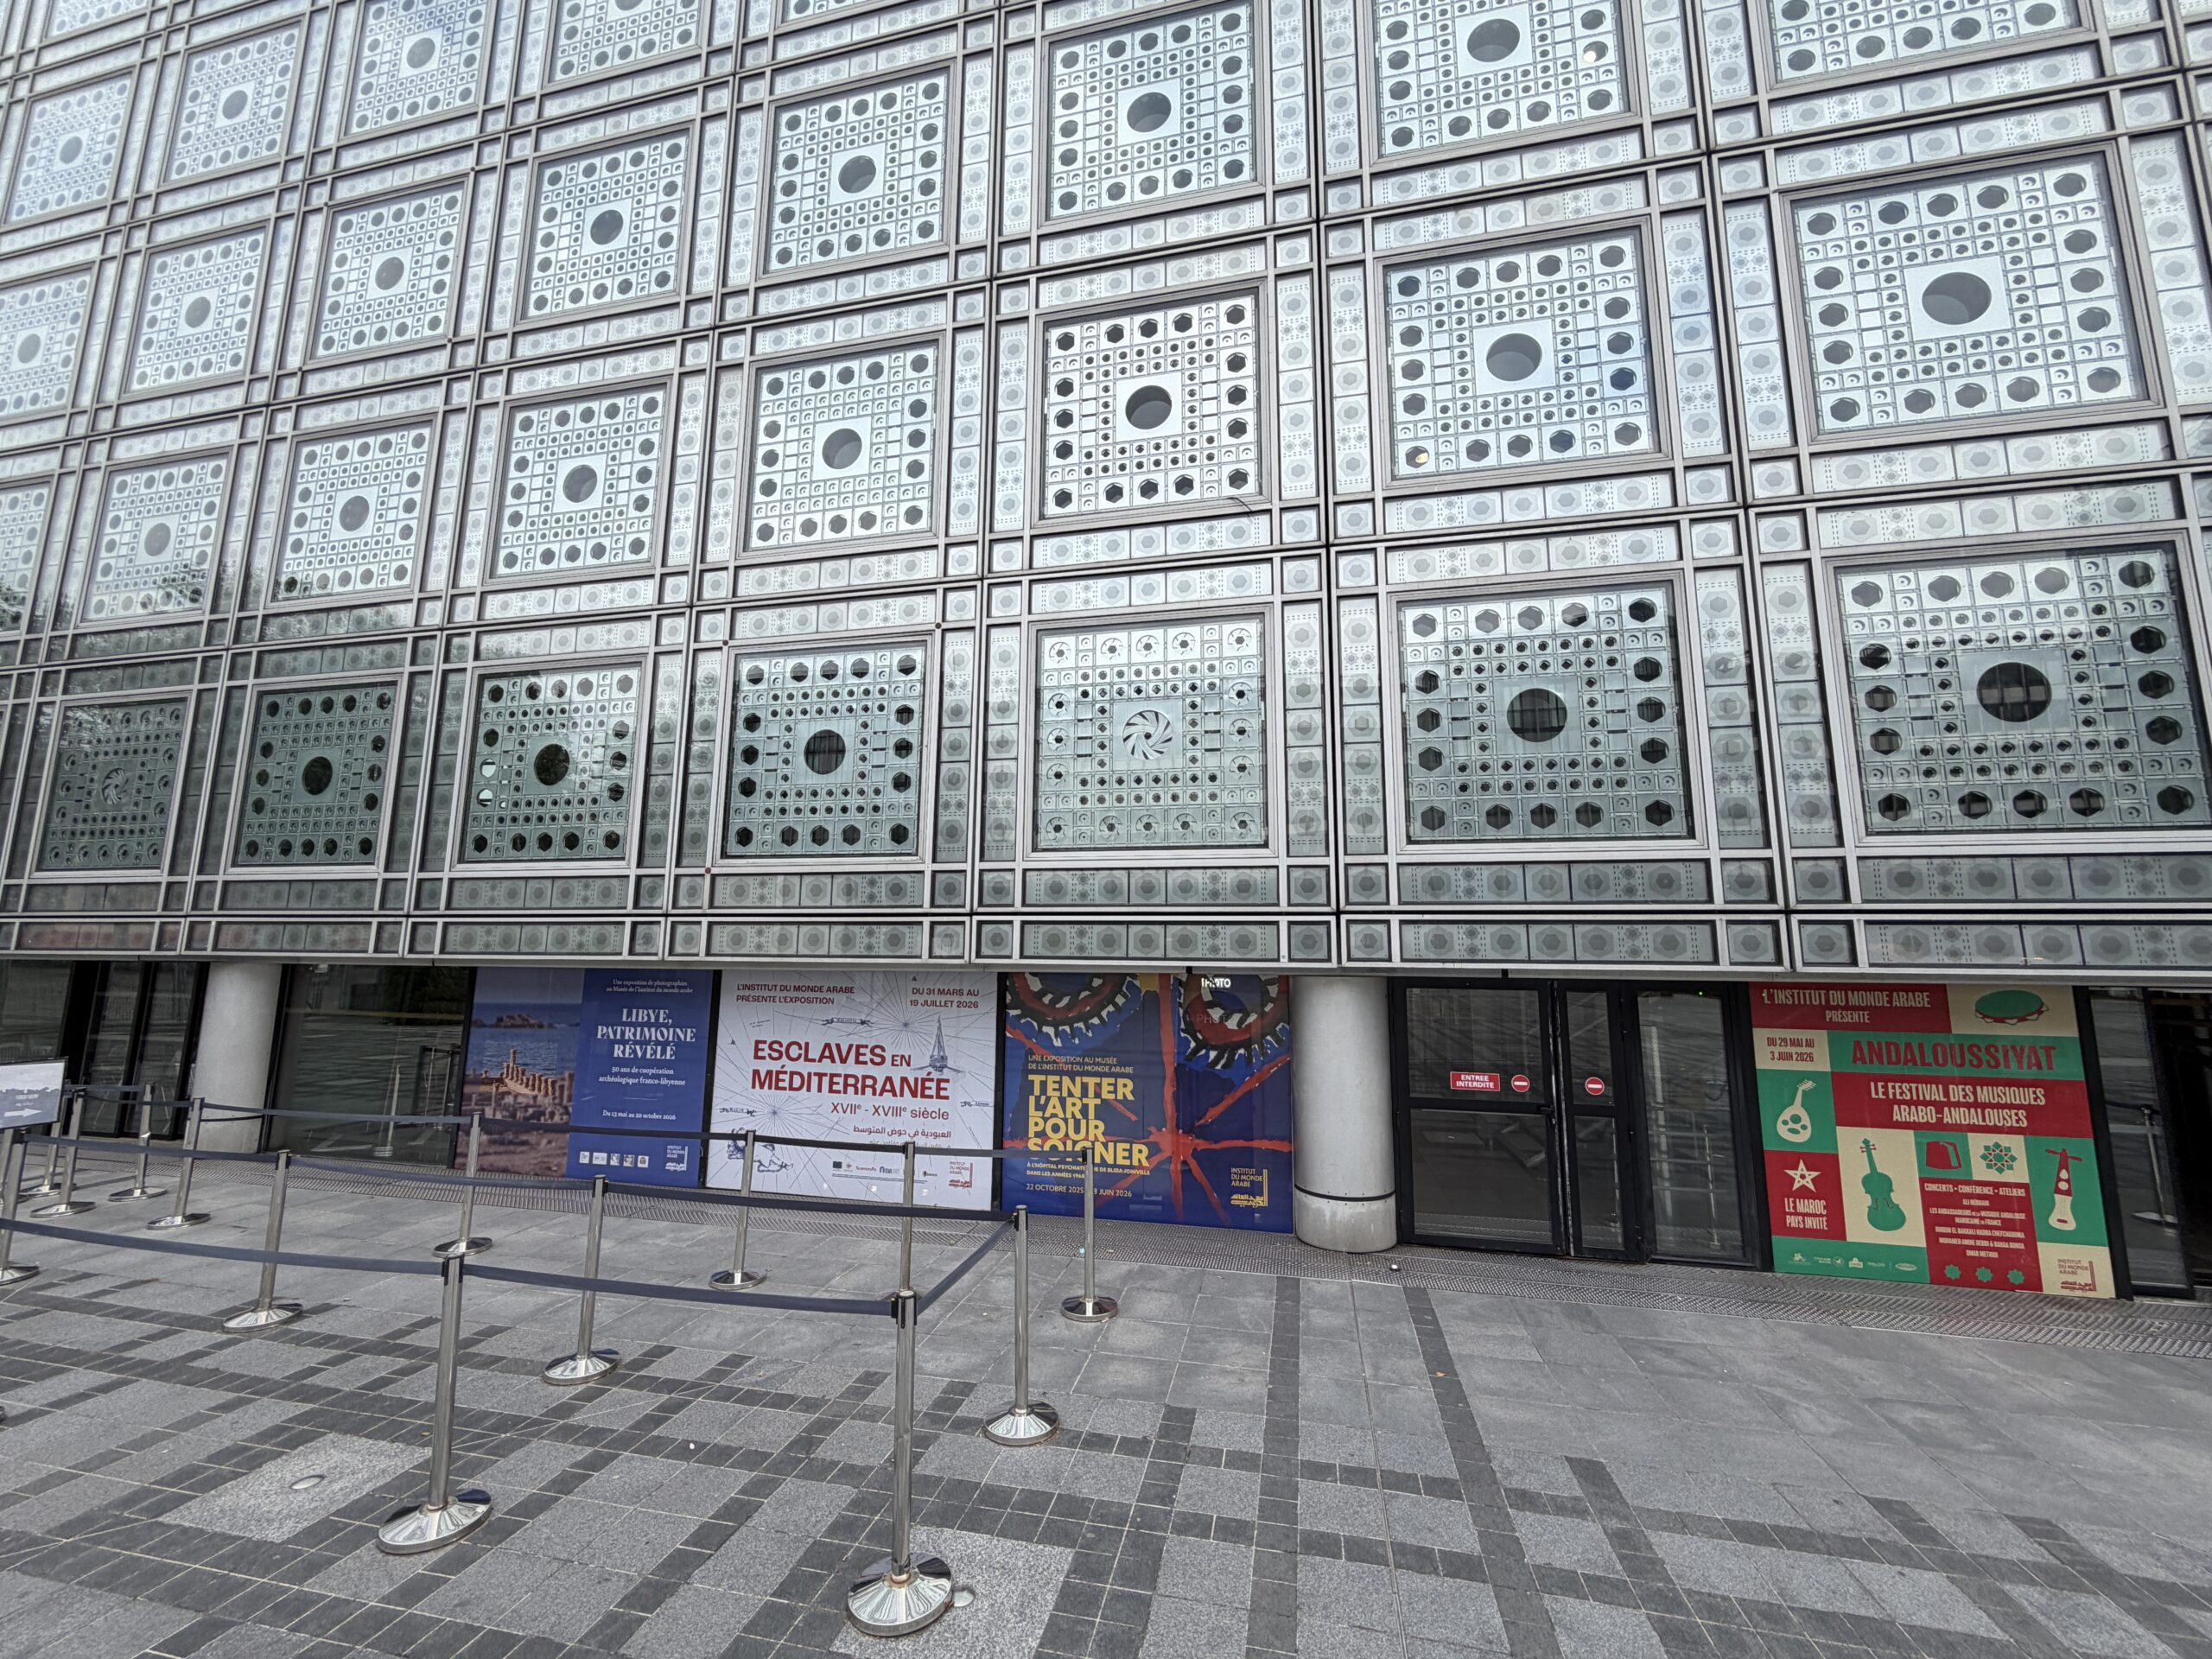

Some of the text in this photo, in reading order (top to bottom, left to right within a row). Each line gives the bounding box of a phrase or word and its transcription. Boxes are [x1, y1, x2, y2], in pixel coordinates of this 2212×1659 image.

[737, 983, 778, 992] L'INSTITUT
[736, 994, 835, 1005] PRÉSENTE L'EXPOSITION
[1764, 989, 1931, 1007] L'INSTITUT DU MONDE ARABE
[622, 1008, 672, 1026] LIBYE,
[1826, 1009, 1870, 1023] PRÉSENTE
[596, 1025, 696, 1042] PATRIMOINE
[613, 1041, 676, 1059] RÉVÉLÉ
[1767, 1037, 1815, 1048] DU 29 MAI AU
[753, 1039, 912, 1067] ESCLAVES EN
[1096, 1056, 1118, 1065] MUSÉE
[1770, 1051, 1814, 1063] 3 JUIN 2026
[1853, 1040, 2056, 1071] ANDALOUSSIYAT
[599, 1075, 686, 1086] archéologique franco-libyenne
[751, 1065, 950, 1100] MÉDITERRANÉE
[1028, 1075, 1135, 1101] TENTER
[1870, 1081, 2046, 1106] LE FESTIVAL DES MUSIQUES
[831, 1103, 861, 1115] XVIIe
[872, 1104, 907, 1117] XVIIIe
[910, 1108, 950, 1120] siècle
[1028, 1096, 1101, 1120] L'ART
[1892, 1104, 2028, 1128] ARABO-ANDALOUSES
[854, 1125, 951, 1140] العبودية في حوض المتوسط
[1028, 1116, 1106, 1141] POUR
[1068, 1185, 1084, 1194] 2025
[1924, 1183, 1954, 1192] CONCERTS
[1958, 1184, 1994, 1195] CONFÉRENCE
[1999, 1187, 2026, 1197] ATELIERS
[1784, 1198, 1827, 1215] LE MAROC
[1786, 1215, 1828, 1230] PAYS INVITÉ
